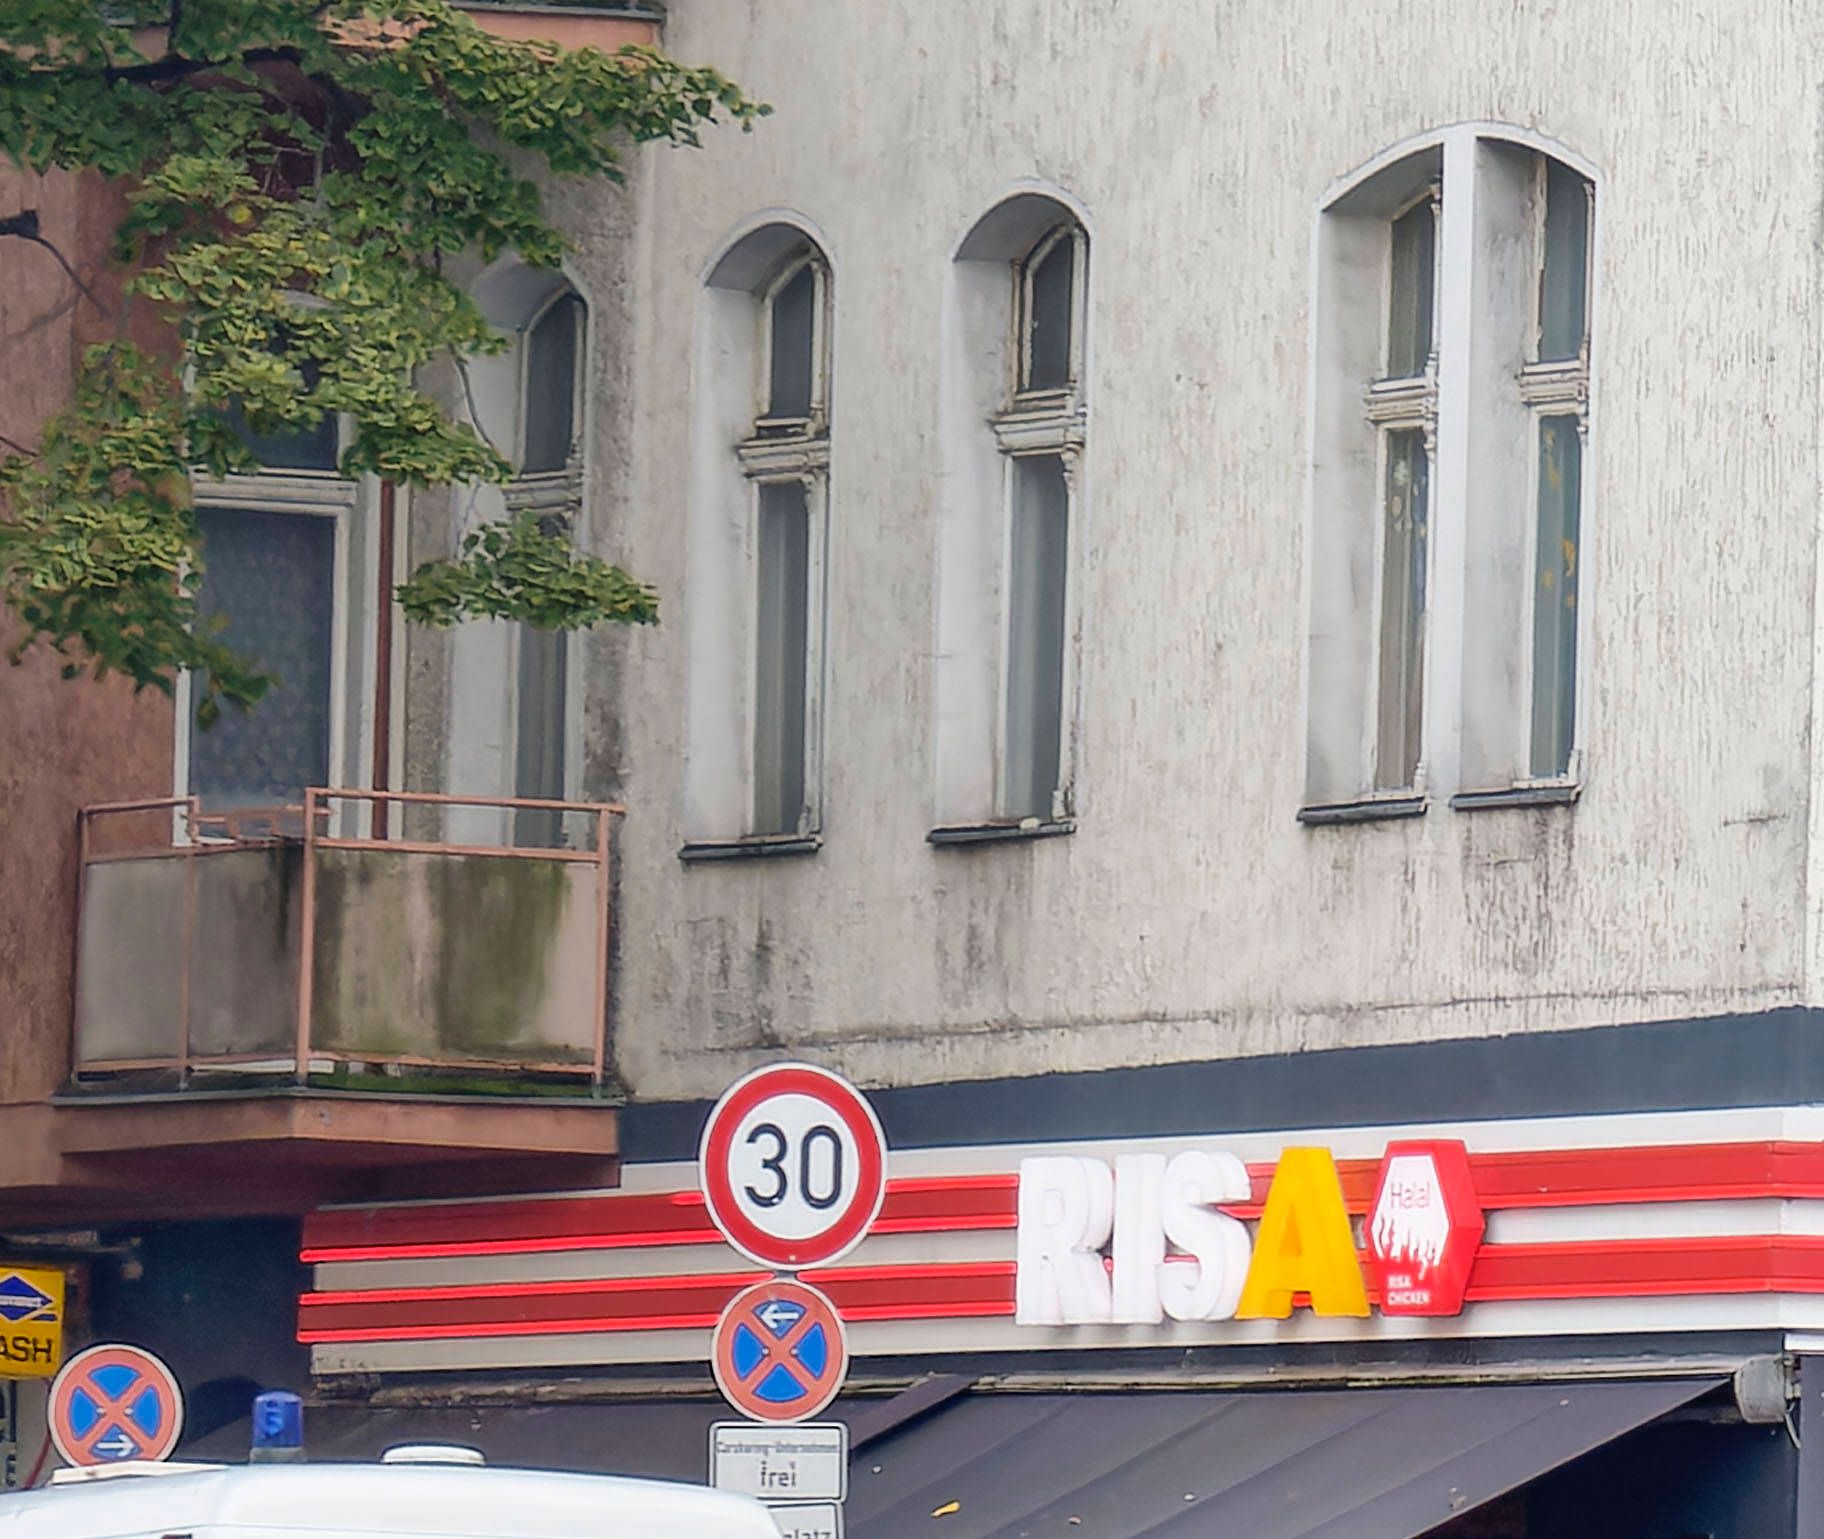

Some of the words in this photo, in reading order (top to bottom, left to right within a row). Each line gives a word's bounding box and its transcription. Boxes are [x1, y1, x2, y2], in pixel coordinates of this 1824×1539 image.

[744, 1123, 843, 1211] 30
[1016, 1145, 1371, 1326] RISA
[760, 1460, 797, 1488] frei
